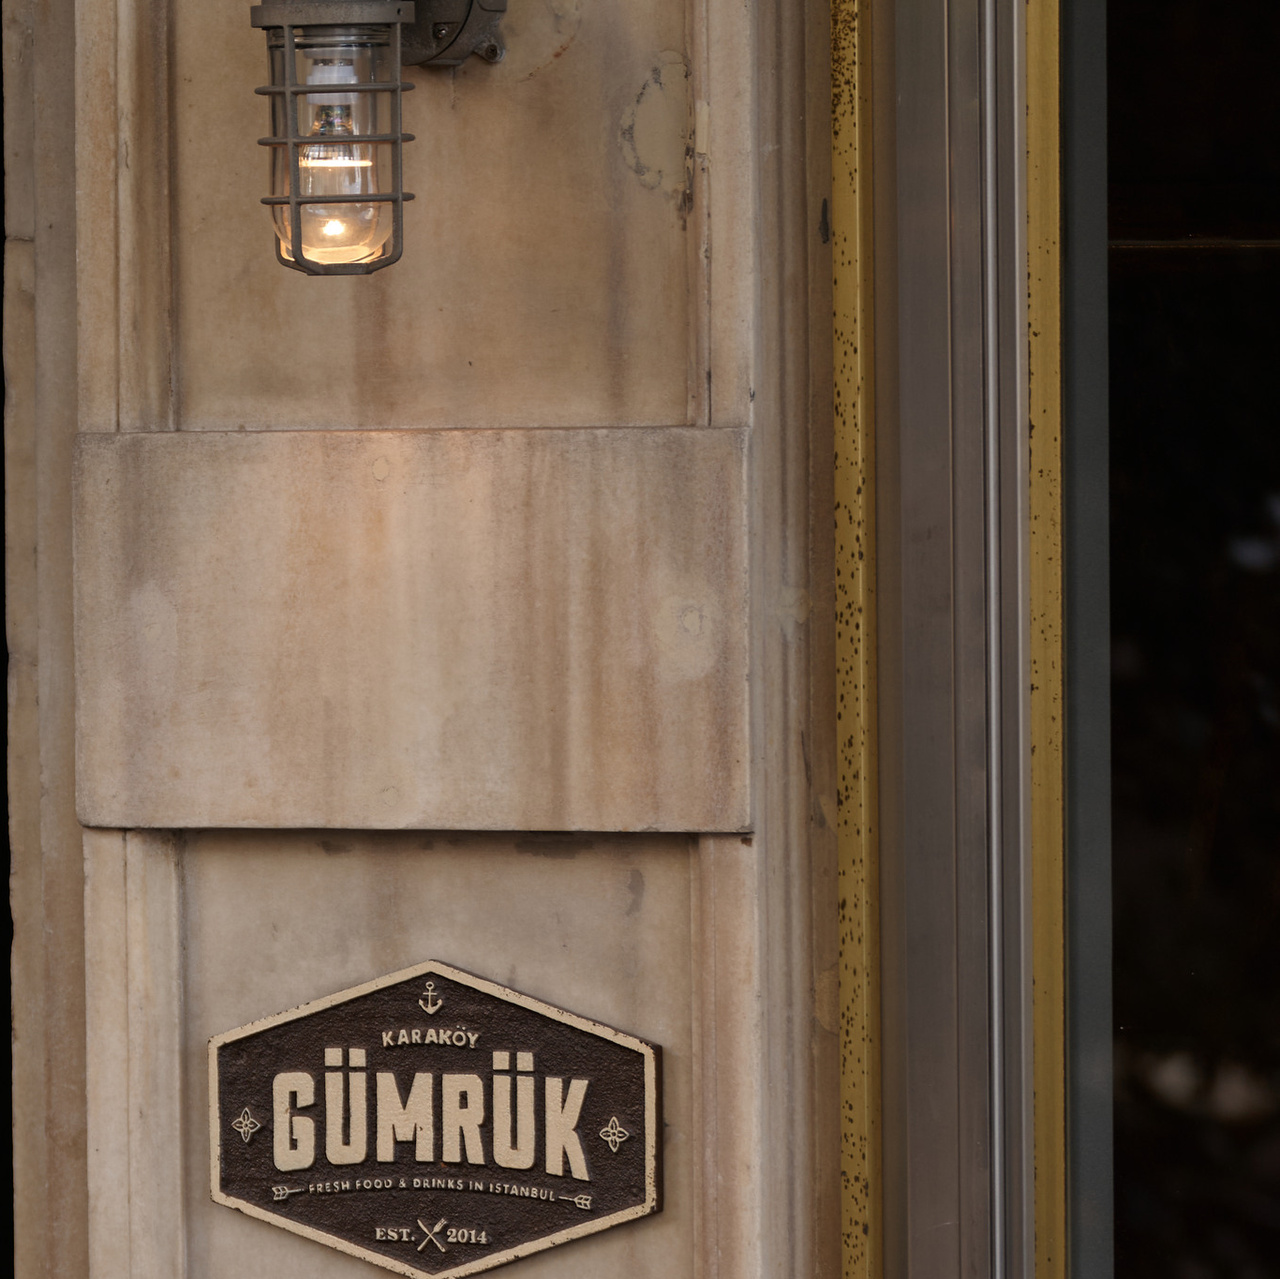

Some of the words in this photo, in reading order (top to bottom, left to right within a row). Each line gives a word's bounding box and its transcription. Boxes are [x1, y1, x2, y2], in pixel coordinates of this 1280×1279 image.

[381, 1025, 479, 1049] KARAKÖY
[272, 1047, 590, 1181] GÜMRÜK
[308, 1180, 350, 1194] FRESH
[355, 1178, 392, 1191] FOOD
[398, 1179, 407, 1189] &
[413, 1178, 464, 1191] DRINKS
[469, 1180, 484, 1192] IN
[489, 1182, 555, 1202] ISTANBUL
[374, 1227, 416, 1242] EST.
[446, 1228, 488, 1245] 2014
